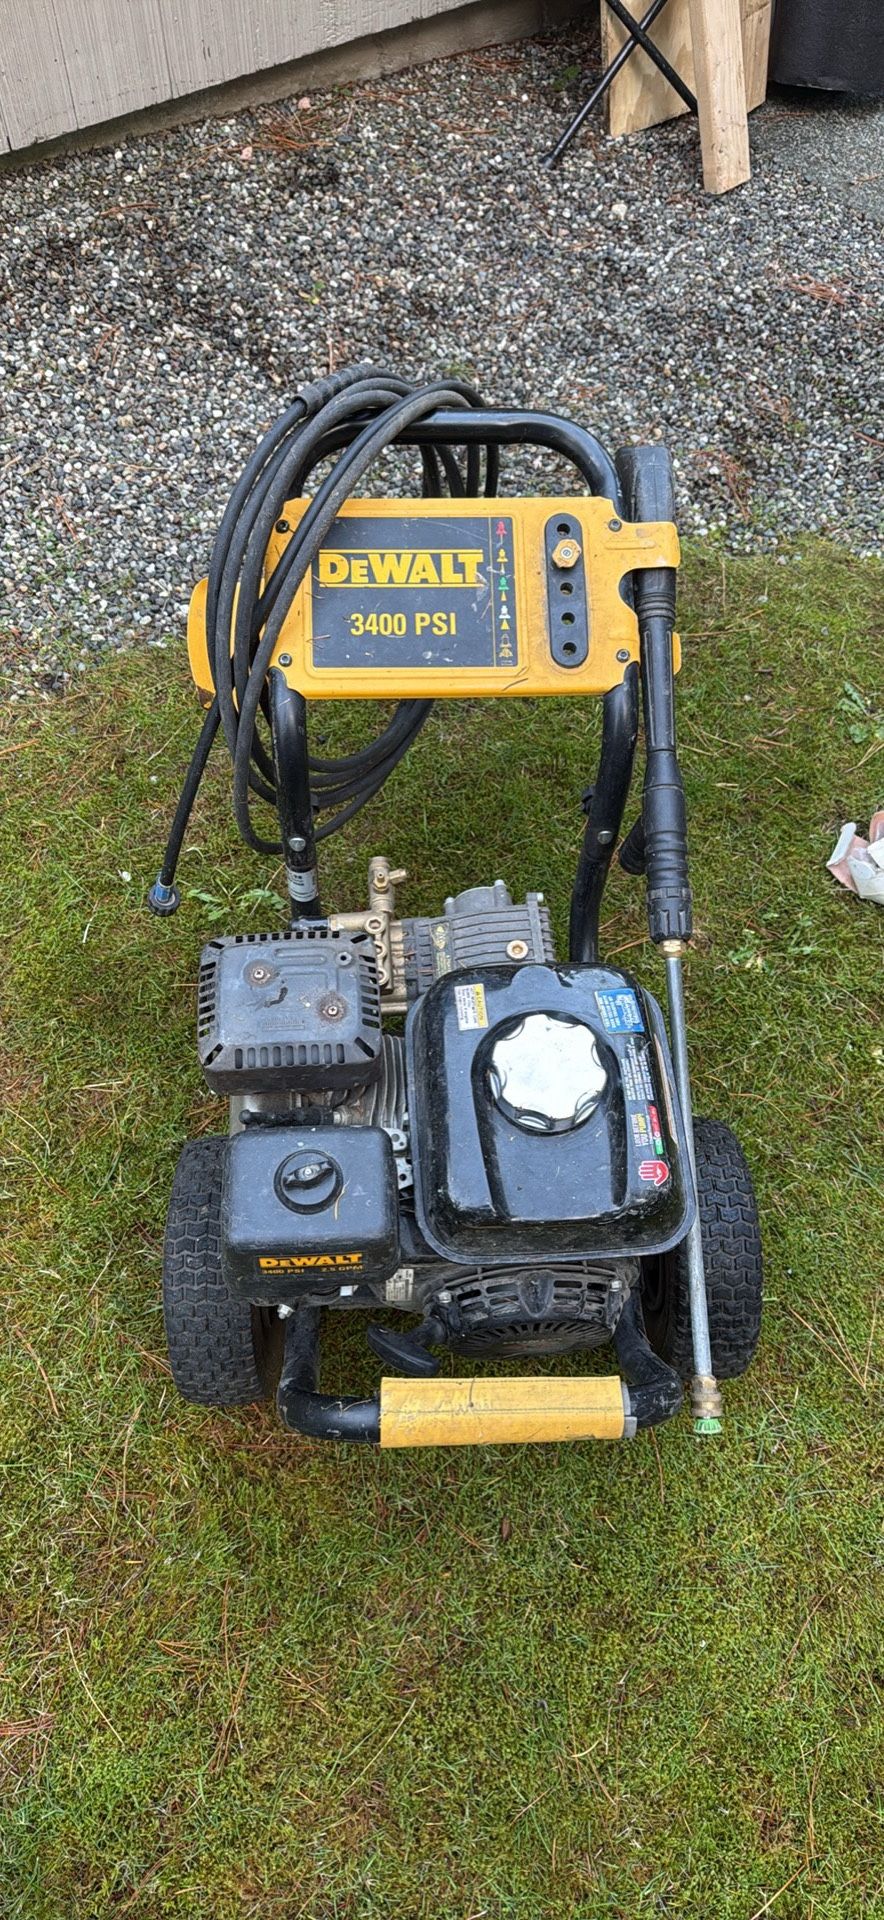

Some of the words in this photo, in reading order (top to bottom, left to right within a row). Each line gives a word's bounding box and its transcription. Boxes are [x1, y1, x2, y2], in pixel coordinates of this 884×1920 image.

[350, 612, 407, 636] 3400
[414, 612, 457, 636] PSI
[338, 1265, 363, 1273] GPM
